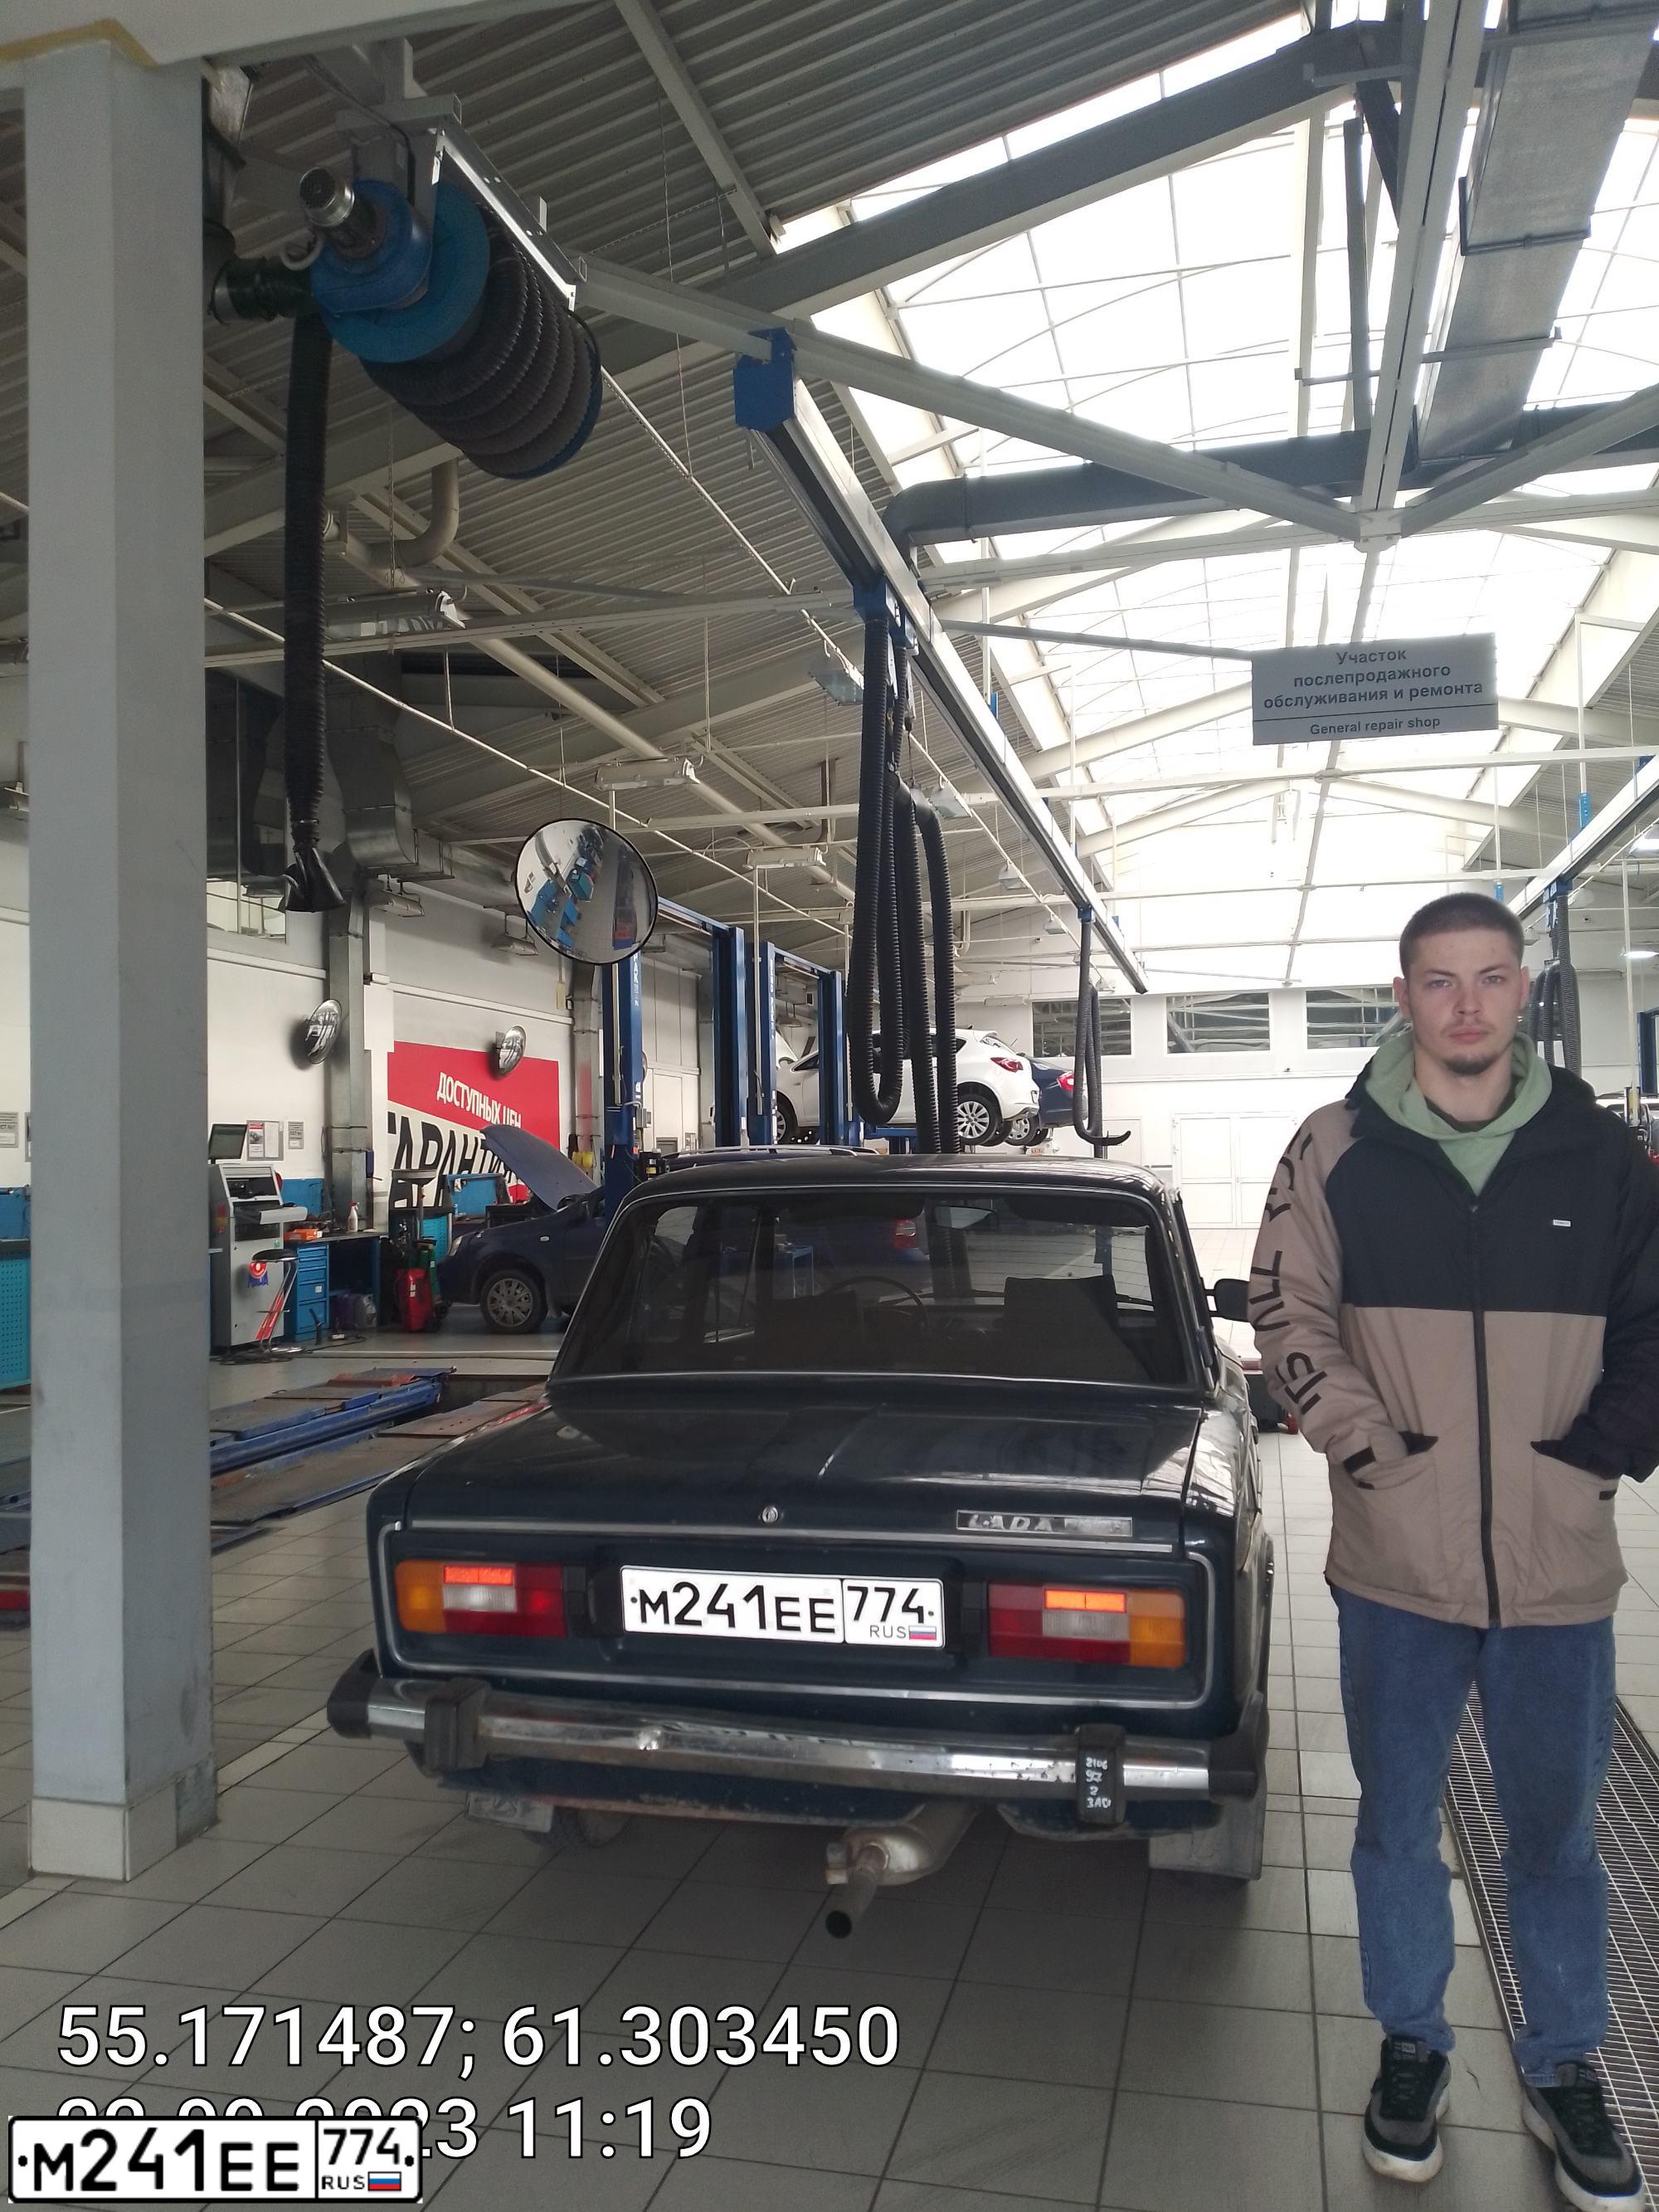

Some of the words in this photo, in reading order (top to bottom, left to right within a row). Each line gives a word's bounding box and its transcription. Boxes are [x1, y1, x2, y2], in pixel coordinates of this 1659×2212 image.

[1336, 650, 1407, 665] Участок
[1294, 666, 1451, 688] послепродажного
[1264, 688, 1388, 709] обслуживания
[1394, 688, 1404, 699] и
[1409, 683, 1483, 701] ремонта
[1310, 721, 1361, 735] General
[1365, 719, 1403, 733] repair
[1408, 717, 1441, 729] shop
[436, 1071, 501, 1124] ДОСТУПНЫХ
[847, 1586, 925, 1624] 774
[869, 1624, 907, 1640] RUS
[1085, 1756, 1108, 1771] 2106
[1089, 1786, 1099, 1796] 2
